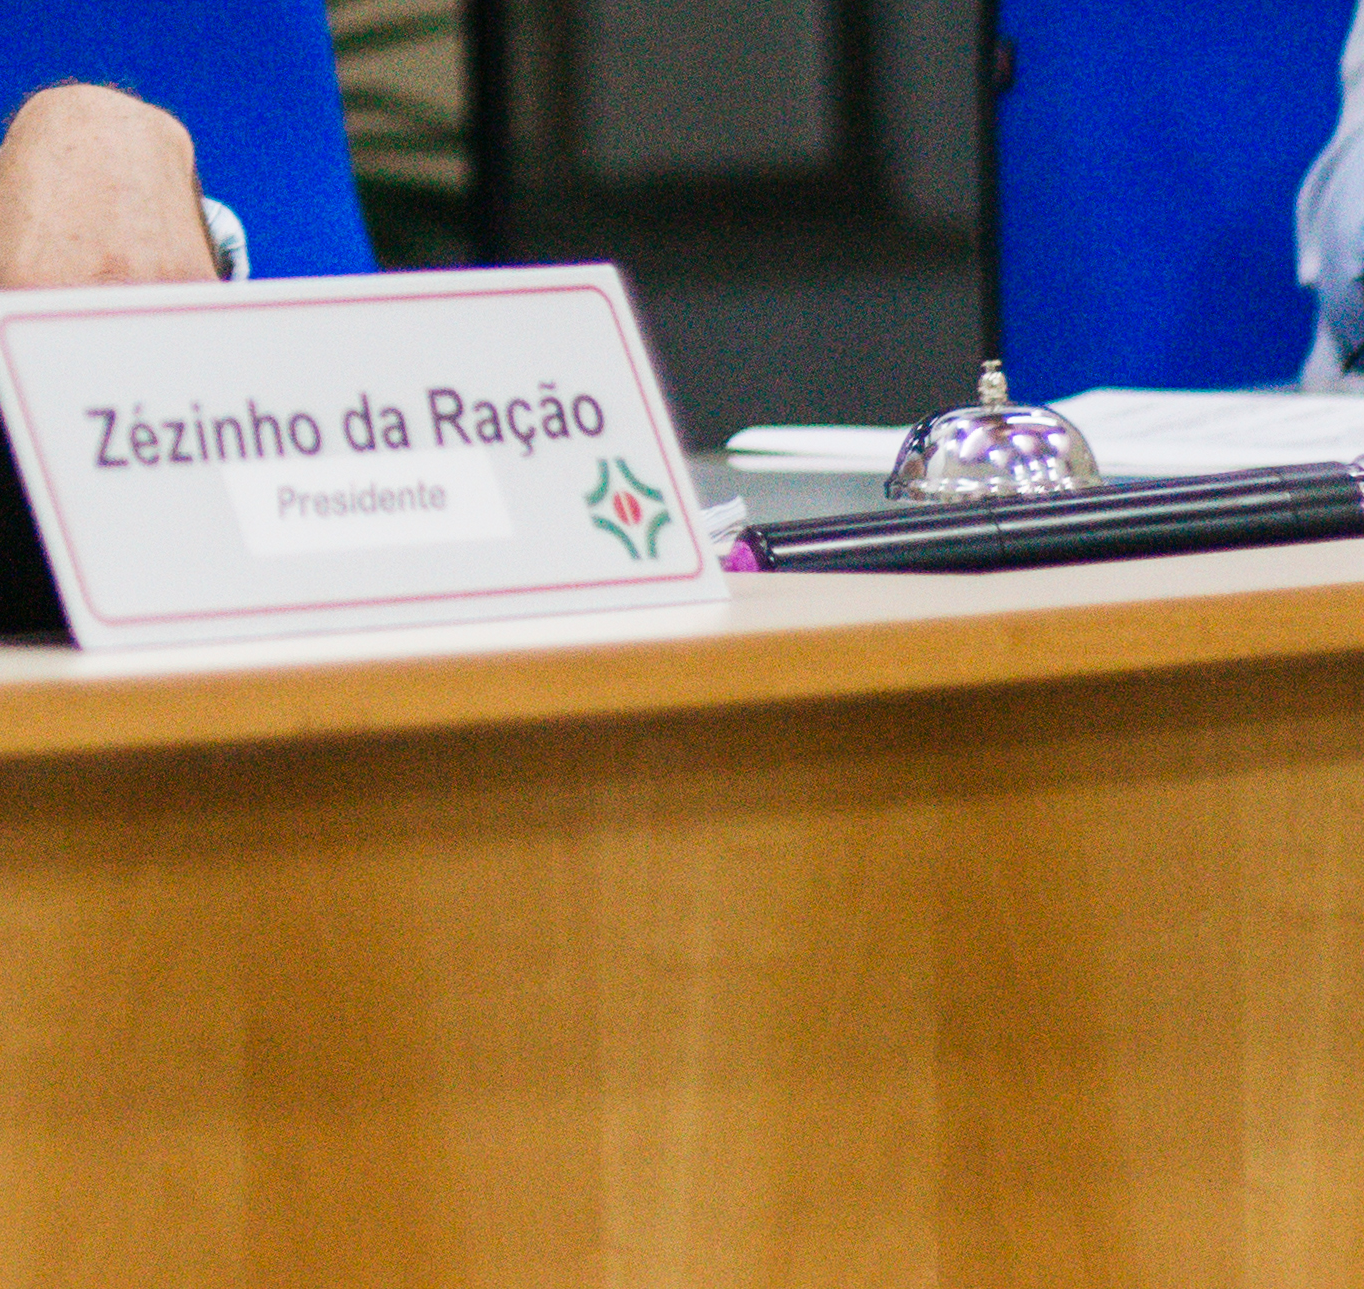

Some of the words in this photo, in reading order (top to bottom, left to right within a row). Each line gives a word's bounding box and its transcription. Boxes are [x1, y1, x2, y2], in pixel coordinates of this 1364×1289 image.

[86, 398, 322, 467] Zézinho
[344, 393, 409, 452] da
[428, 381, 605, 456] Ração
[277, 479, 446, 520] Presidente
